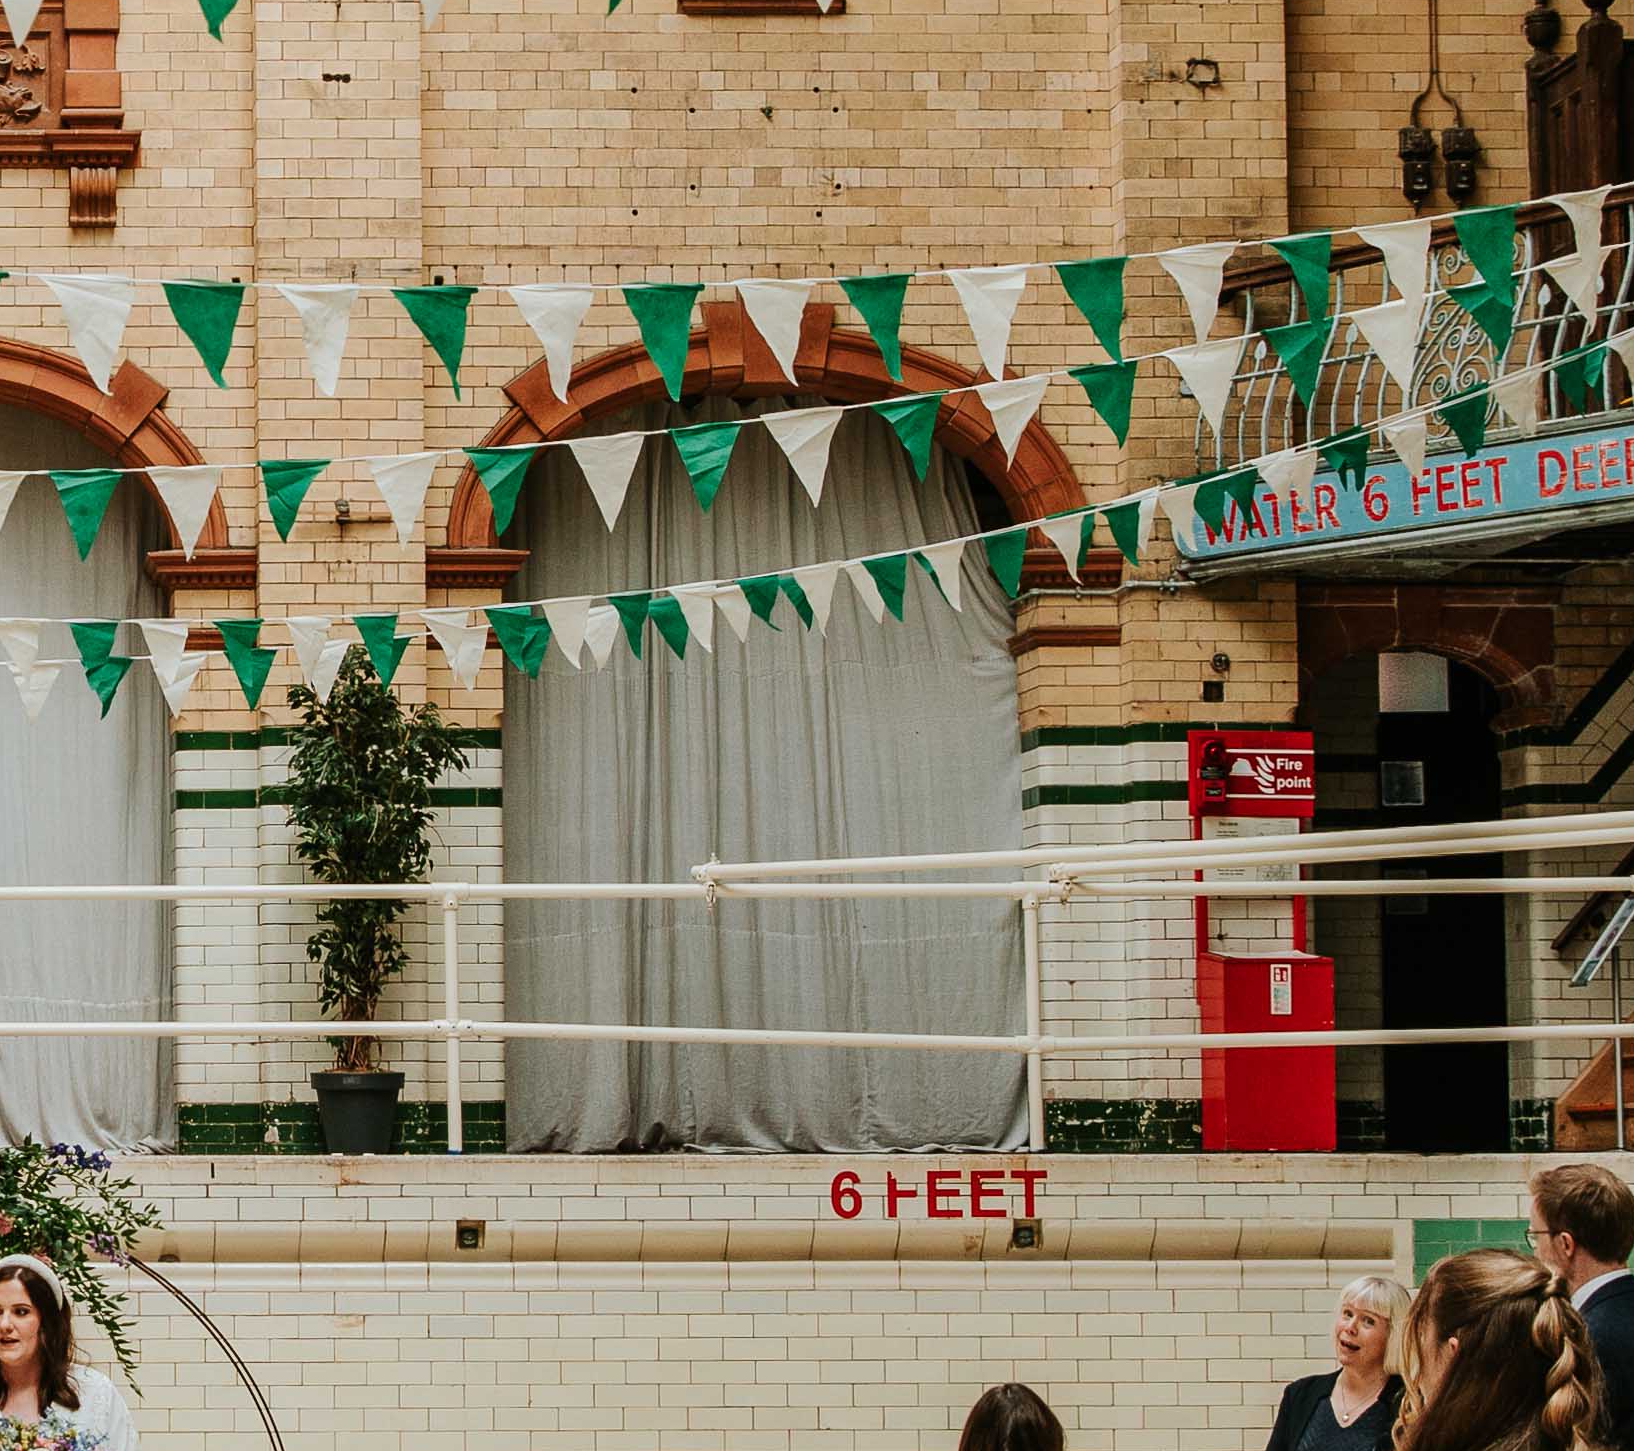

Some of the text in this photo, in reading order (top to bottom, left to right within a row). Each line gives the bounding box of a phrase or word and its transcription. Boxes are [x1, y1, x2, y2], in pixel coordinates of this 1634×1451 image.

[1363, 474, 1390, 522] 6
[1411, 457, 1508, 516] FEET
[1275, 757, 1303, 771] Fire
[1276, 775, 1312, 791] point
[831, 1170, 863, 1220] 6
